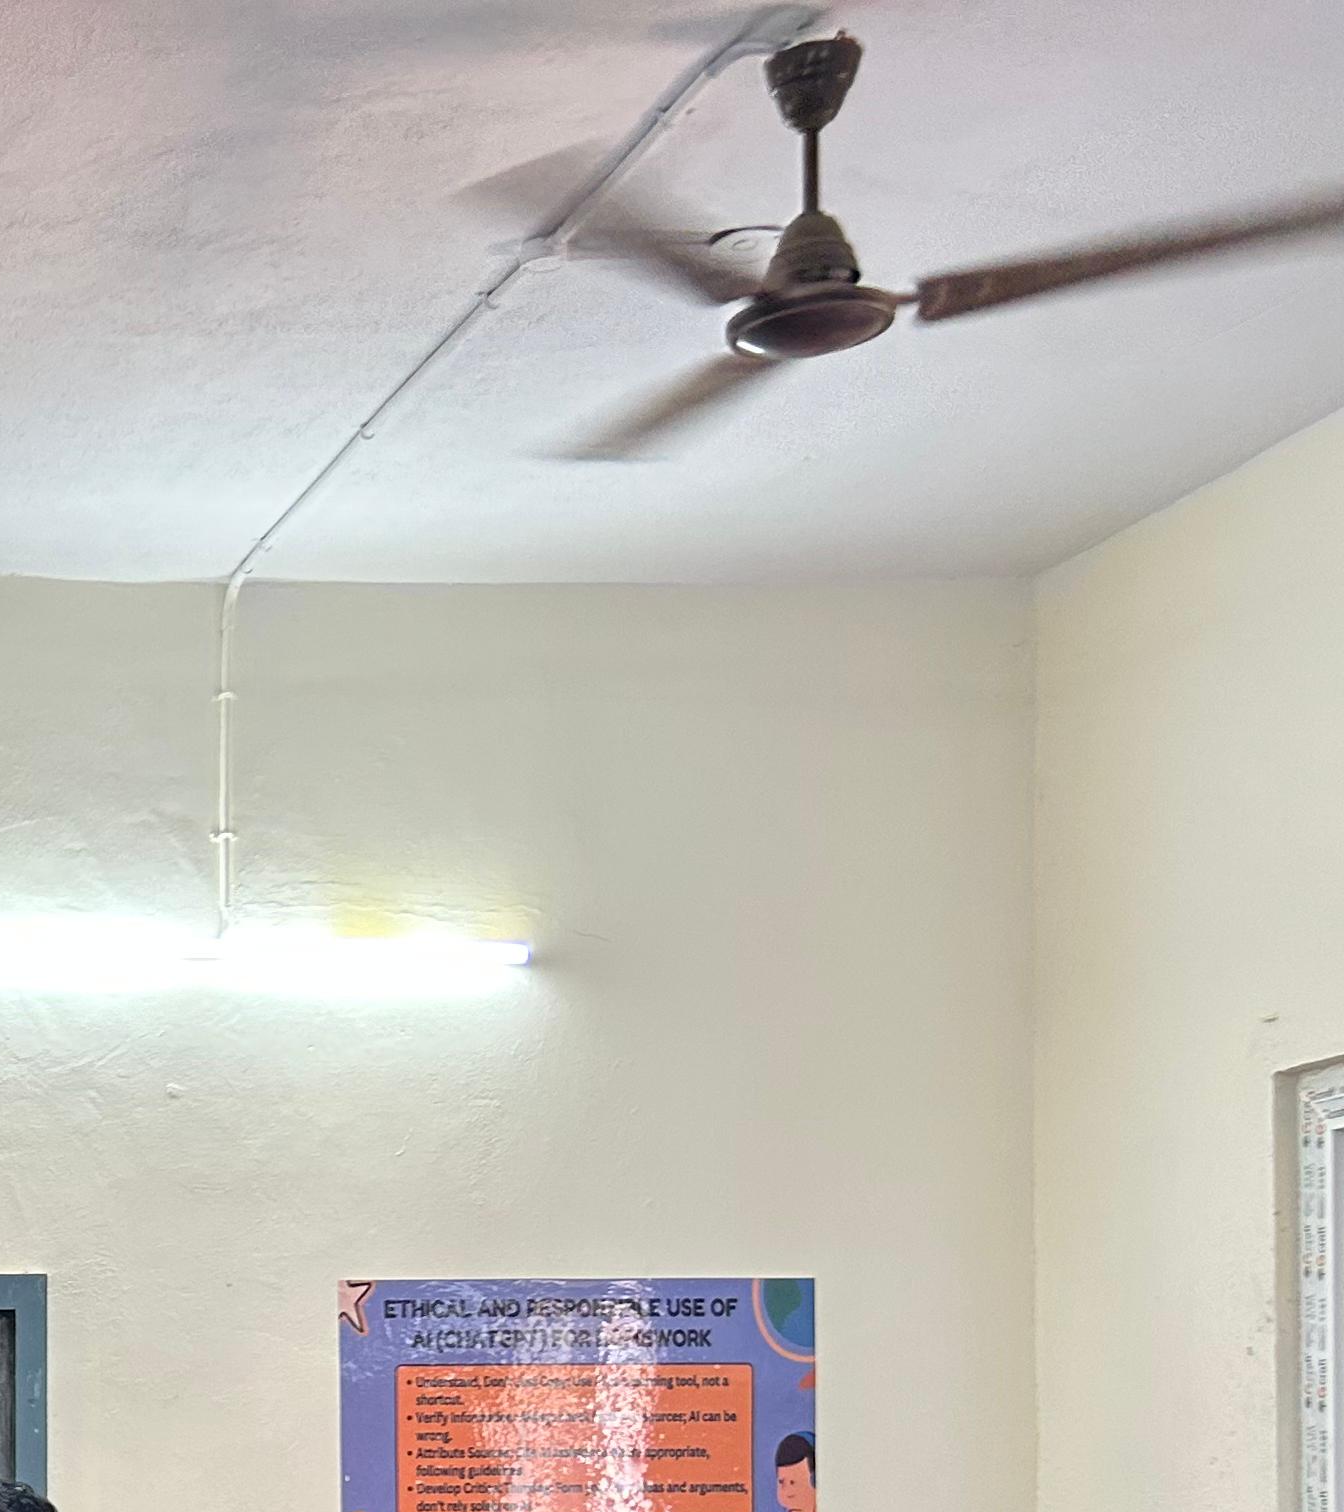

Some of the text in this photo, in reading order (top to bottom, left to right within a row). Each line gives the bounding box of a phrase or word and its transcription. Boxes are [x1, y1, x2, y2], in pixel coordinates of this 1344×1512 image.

[383, 1298, 471, 1319] ETHICAL
[478, 1298, 521, 1318] AND
[667, 1297, 706, 1318] USE
[712, 1297, 738, 1318] OF
[551, 1329, 593, 1349] FOR
[675, 1375, 700, 1389] tool,
[702, 1375, 720, 1387] not
[722, 1378, 729, 1387] a
[415, 1411, 449, 1426] Verify
[688, 1411, 700, 1422] AI
[702, 1412, 721, 1423] can
[724, 1410, 737, 1423] be
[415, 1431, 453, 1444] wrong.
[416, 1447, 465, 1460] Attribute
[416, 1464, 466, 1479] following
[416, 1482, 461, 1496] Develop
[666, 1482, 687, 1494] and
[689, 1483, 749, 1496] arguments,
[416, 1500, 445, 1512] don't
